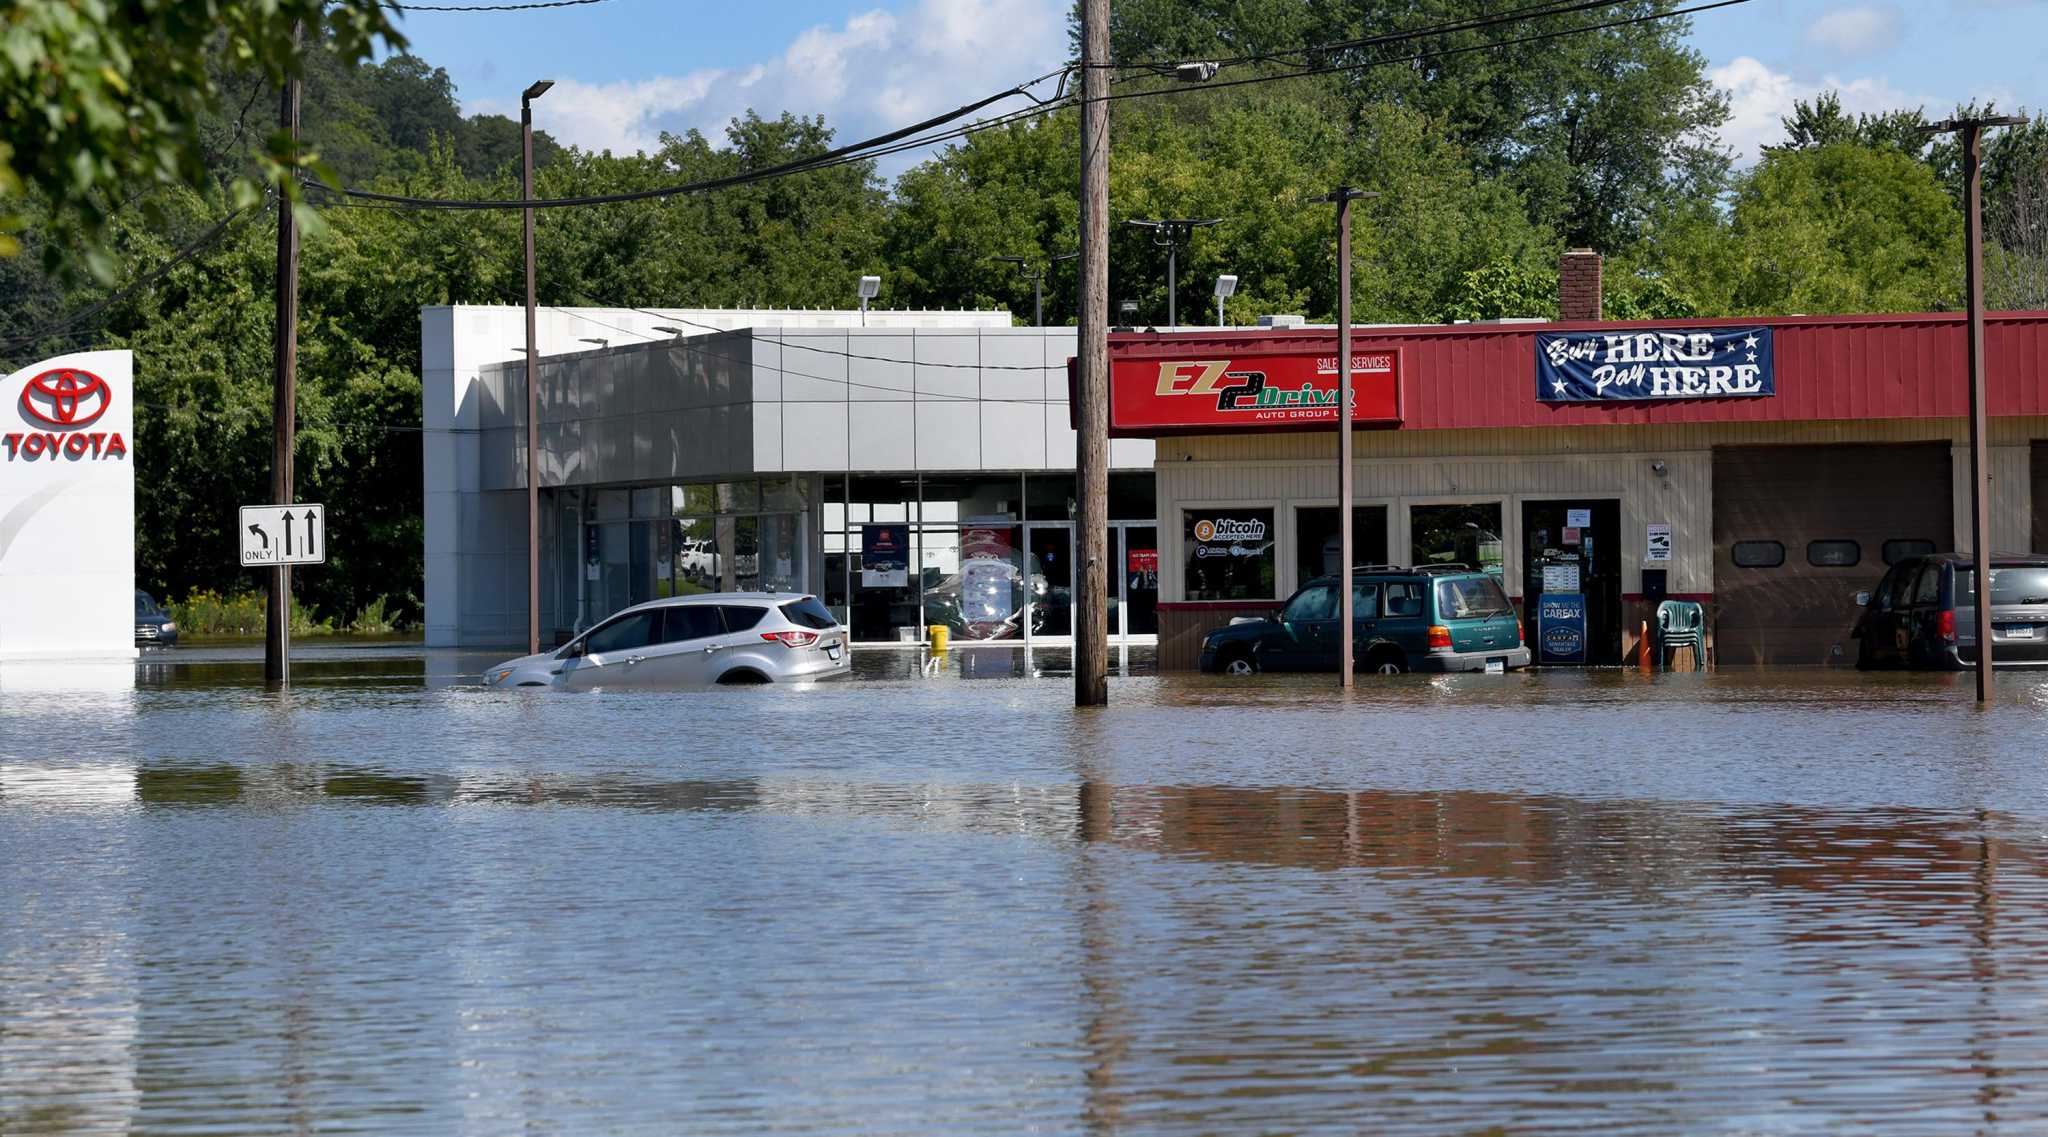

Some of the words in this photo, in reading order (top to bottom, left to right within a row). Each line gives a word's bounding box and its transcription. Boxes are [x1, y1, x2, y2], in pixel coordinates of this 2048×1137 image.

[1546, 337, 1598, 367] Buy
[1603, 333, 1715, 363] HERE
[1352, 356, 1391, 369] SERVICES
[1155, 360, 1231, 396] EZ
[1216, 371, 1266, 411] 2
[1592, 363, 1645, 395] Pay
[1649, 364, 1762, 396] HERE
[1256, 411, 1286, 419] AUTO
[1289, 410, 1330, 418] GROUP
[2, 432, 127, 461] TOYOTA
[1216, 518, 1265, 534] bitcoin
[1214, 533, 1245, 541] ACCEPTED
[245, 550, 273, 561] ONLY
[1543, 609, 1581, 619] CARFAX
